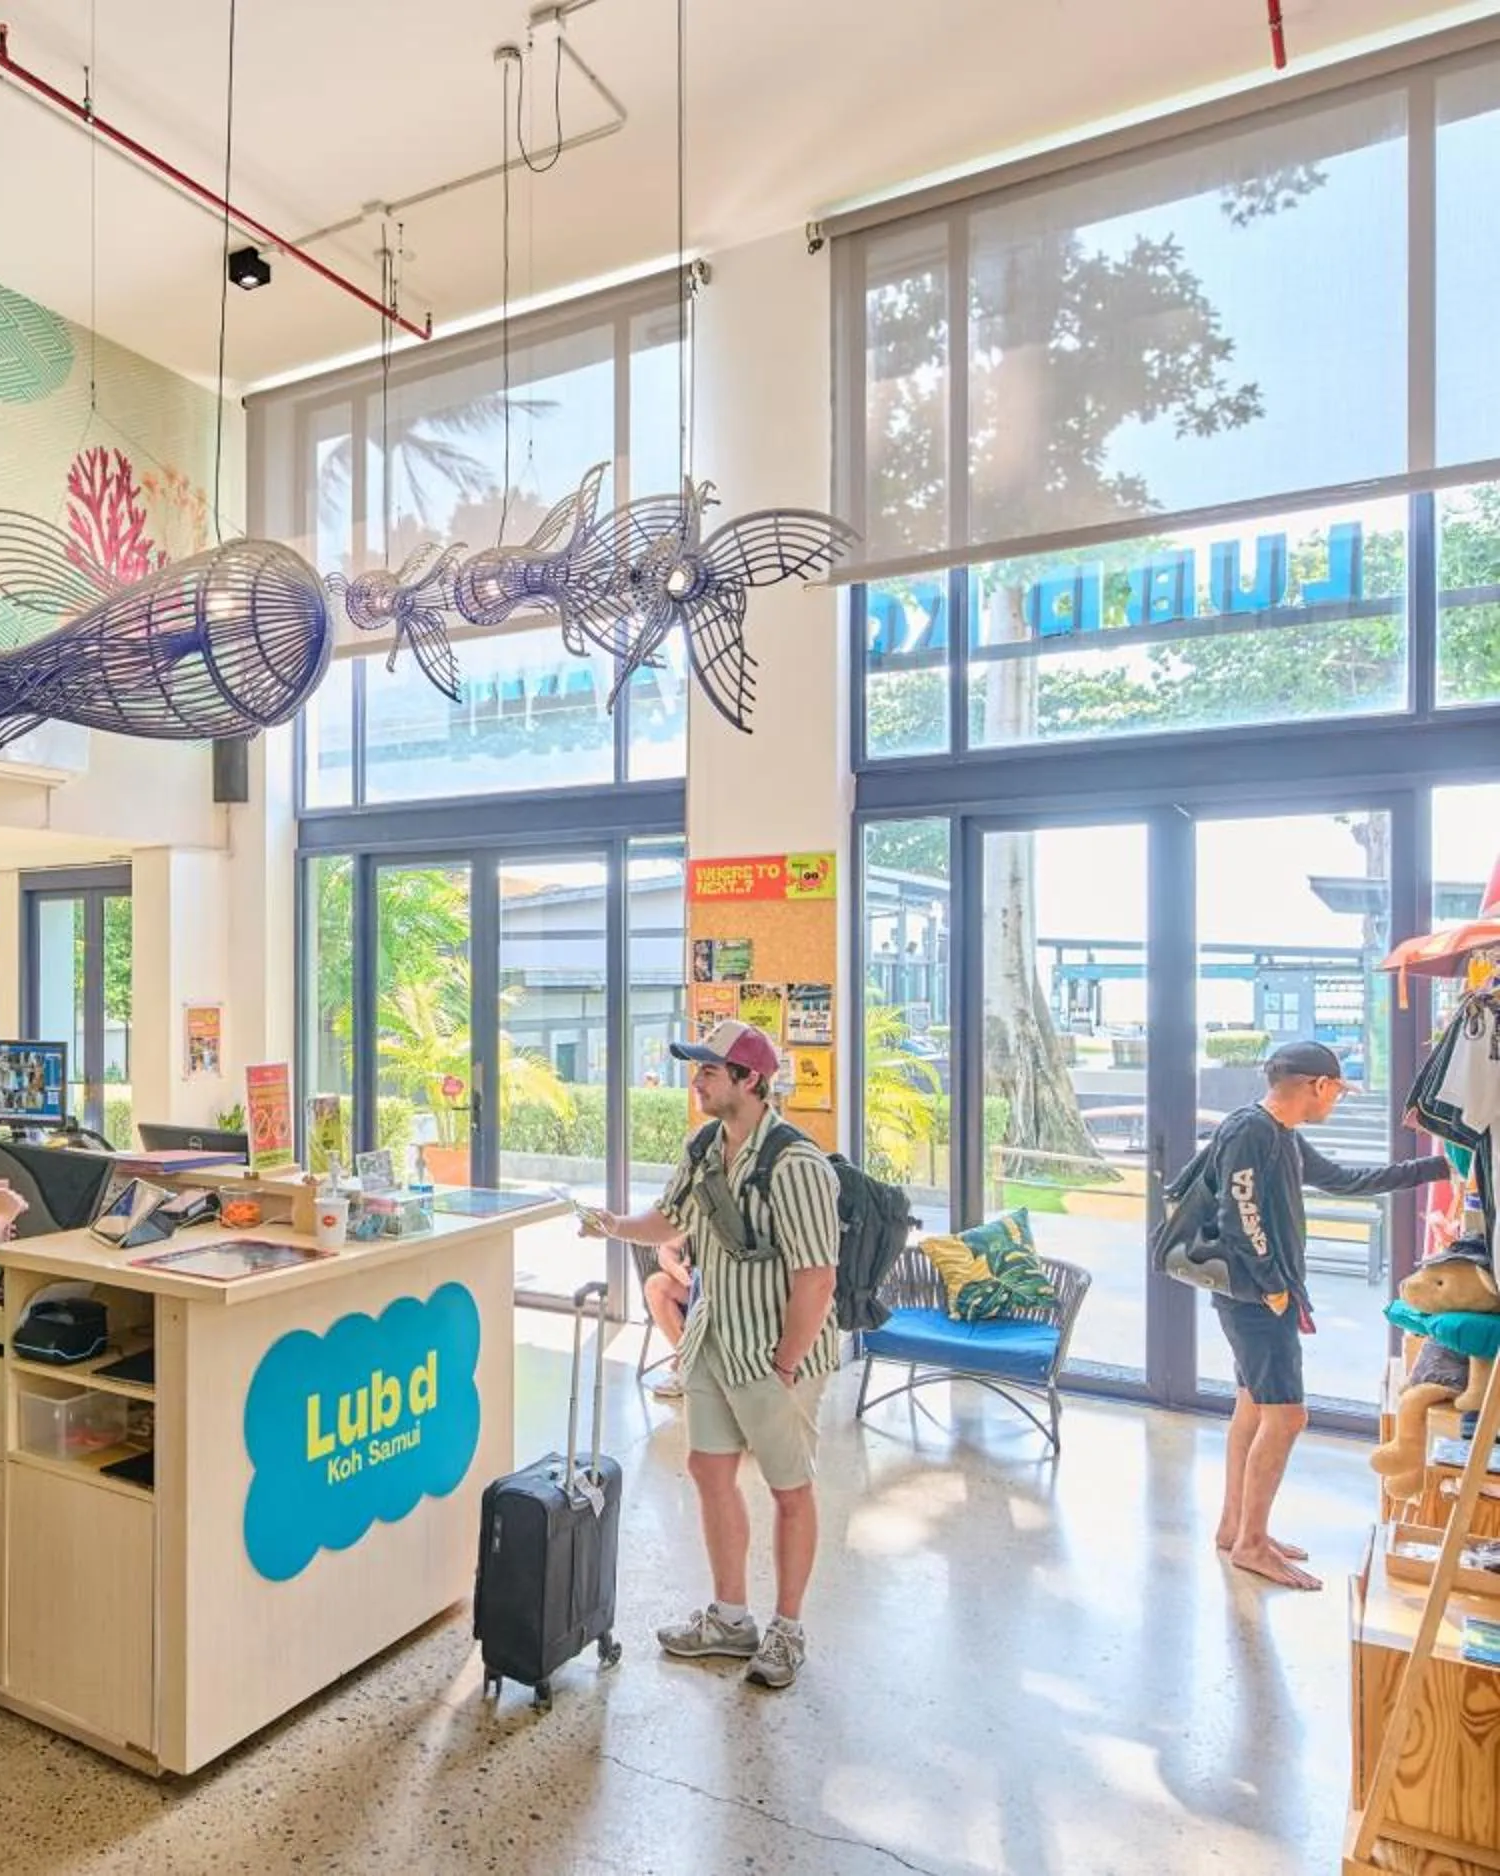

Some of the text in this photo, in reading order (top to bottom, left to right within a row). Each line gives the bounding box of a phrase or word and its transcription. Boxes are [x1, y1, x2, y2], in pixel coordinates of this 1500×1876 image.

[695, 863, 781, 882] WHERE TO
[307, 1350, 437, 1462] Lub d
[326, 1420, 421, 1486] Koh Samui
